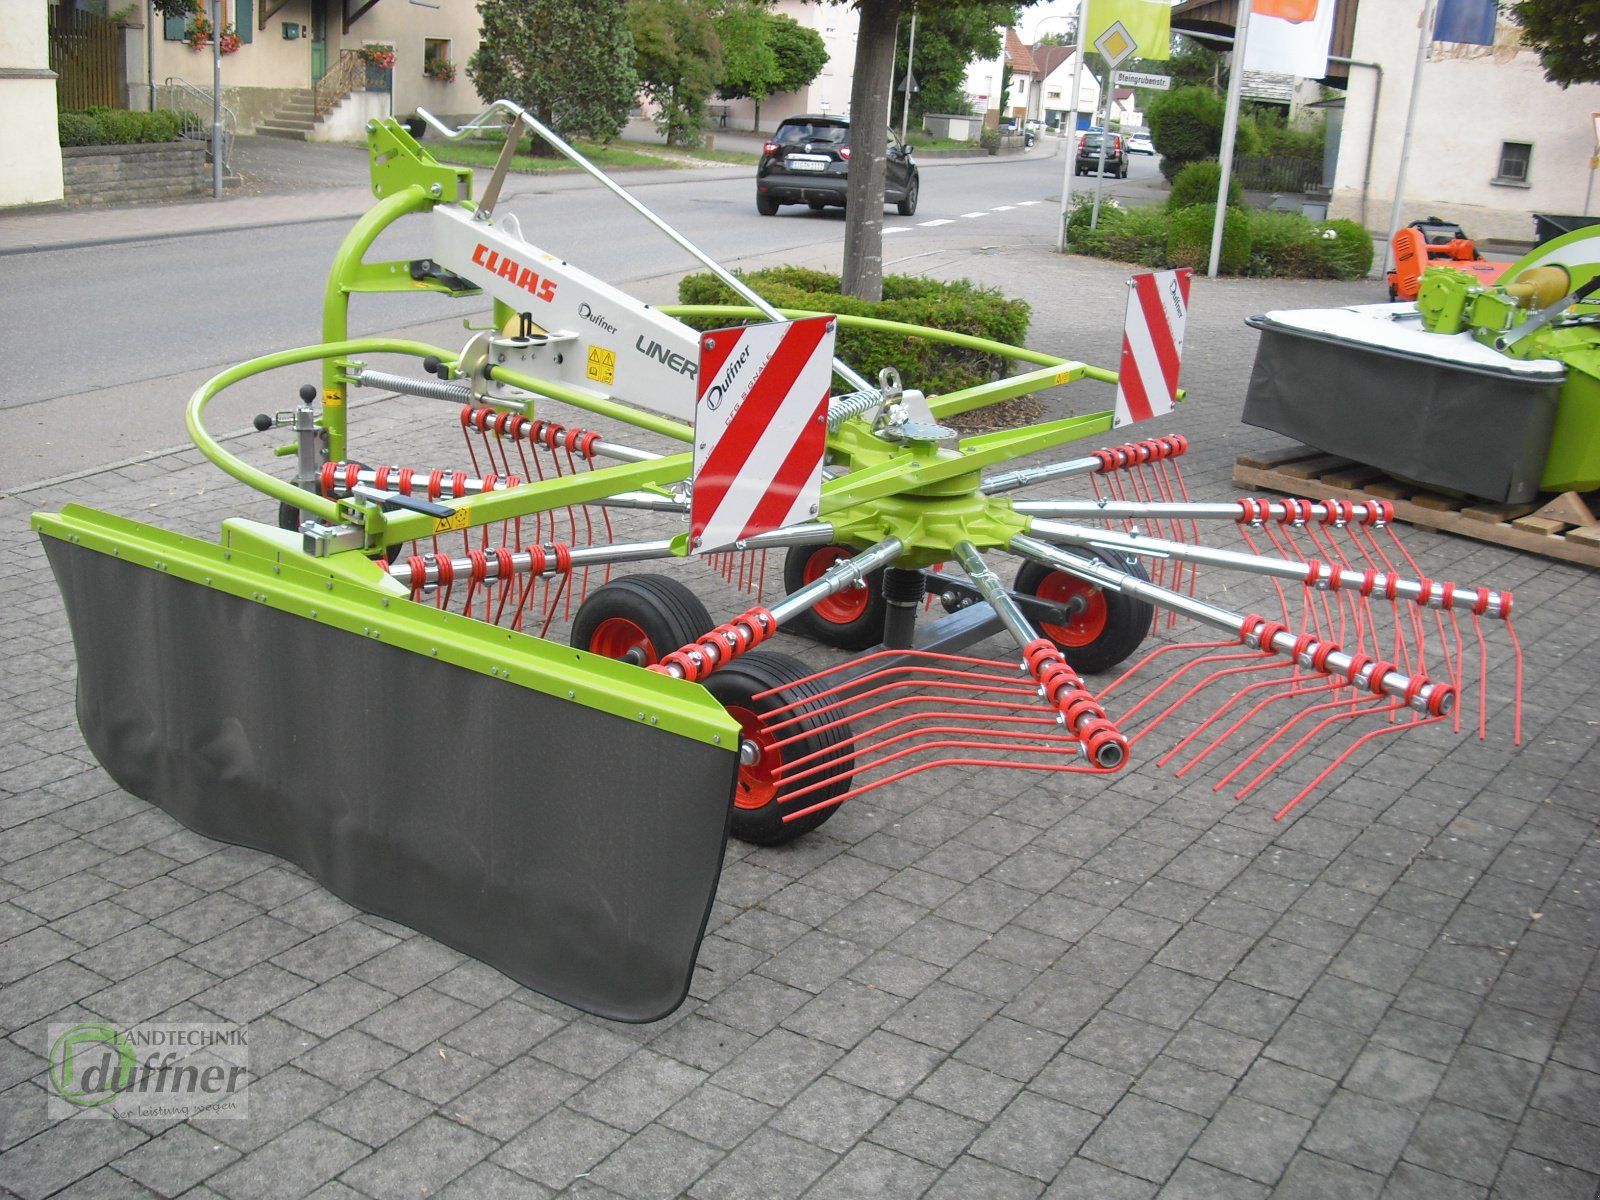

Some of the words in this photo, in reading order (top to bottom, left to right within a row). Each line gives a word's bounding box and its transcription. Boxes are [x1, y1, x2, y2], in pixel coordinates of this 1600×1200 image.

[1118, 73, 1167, 87] Steingrubenstr.
[471, 243, 557, 303] CLAAS
[578, 301, 618, 335] Duffner
[635, 334, 698, 381] LINER
[706, 344, 750, 411] Duffner
